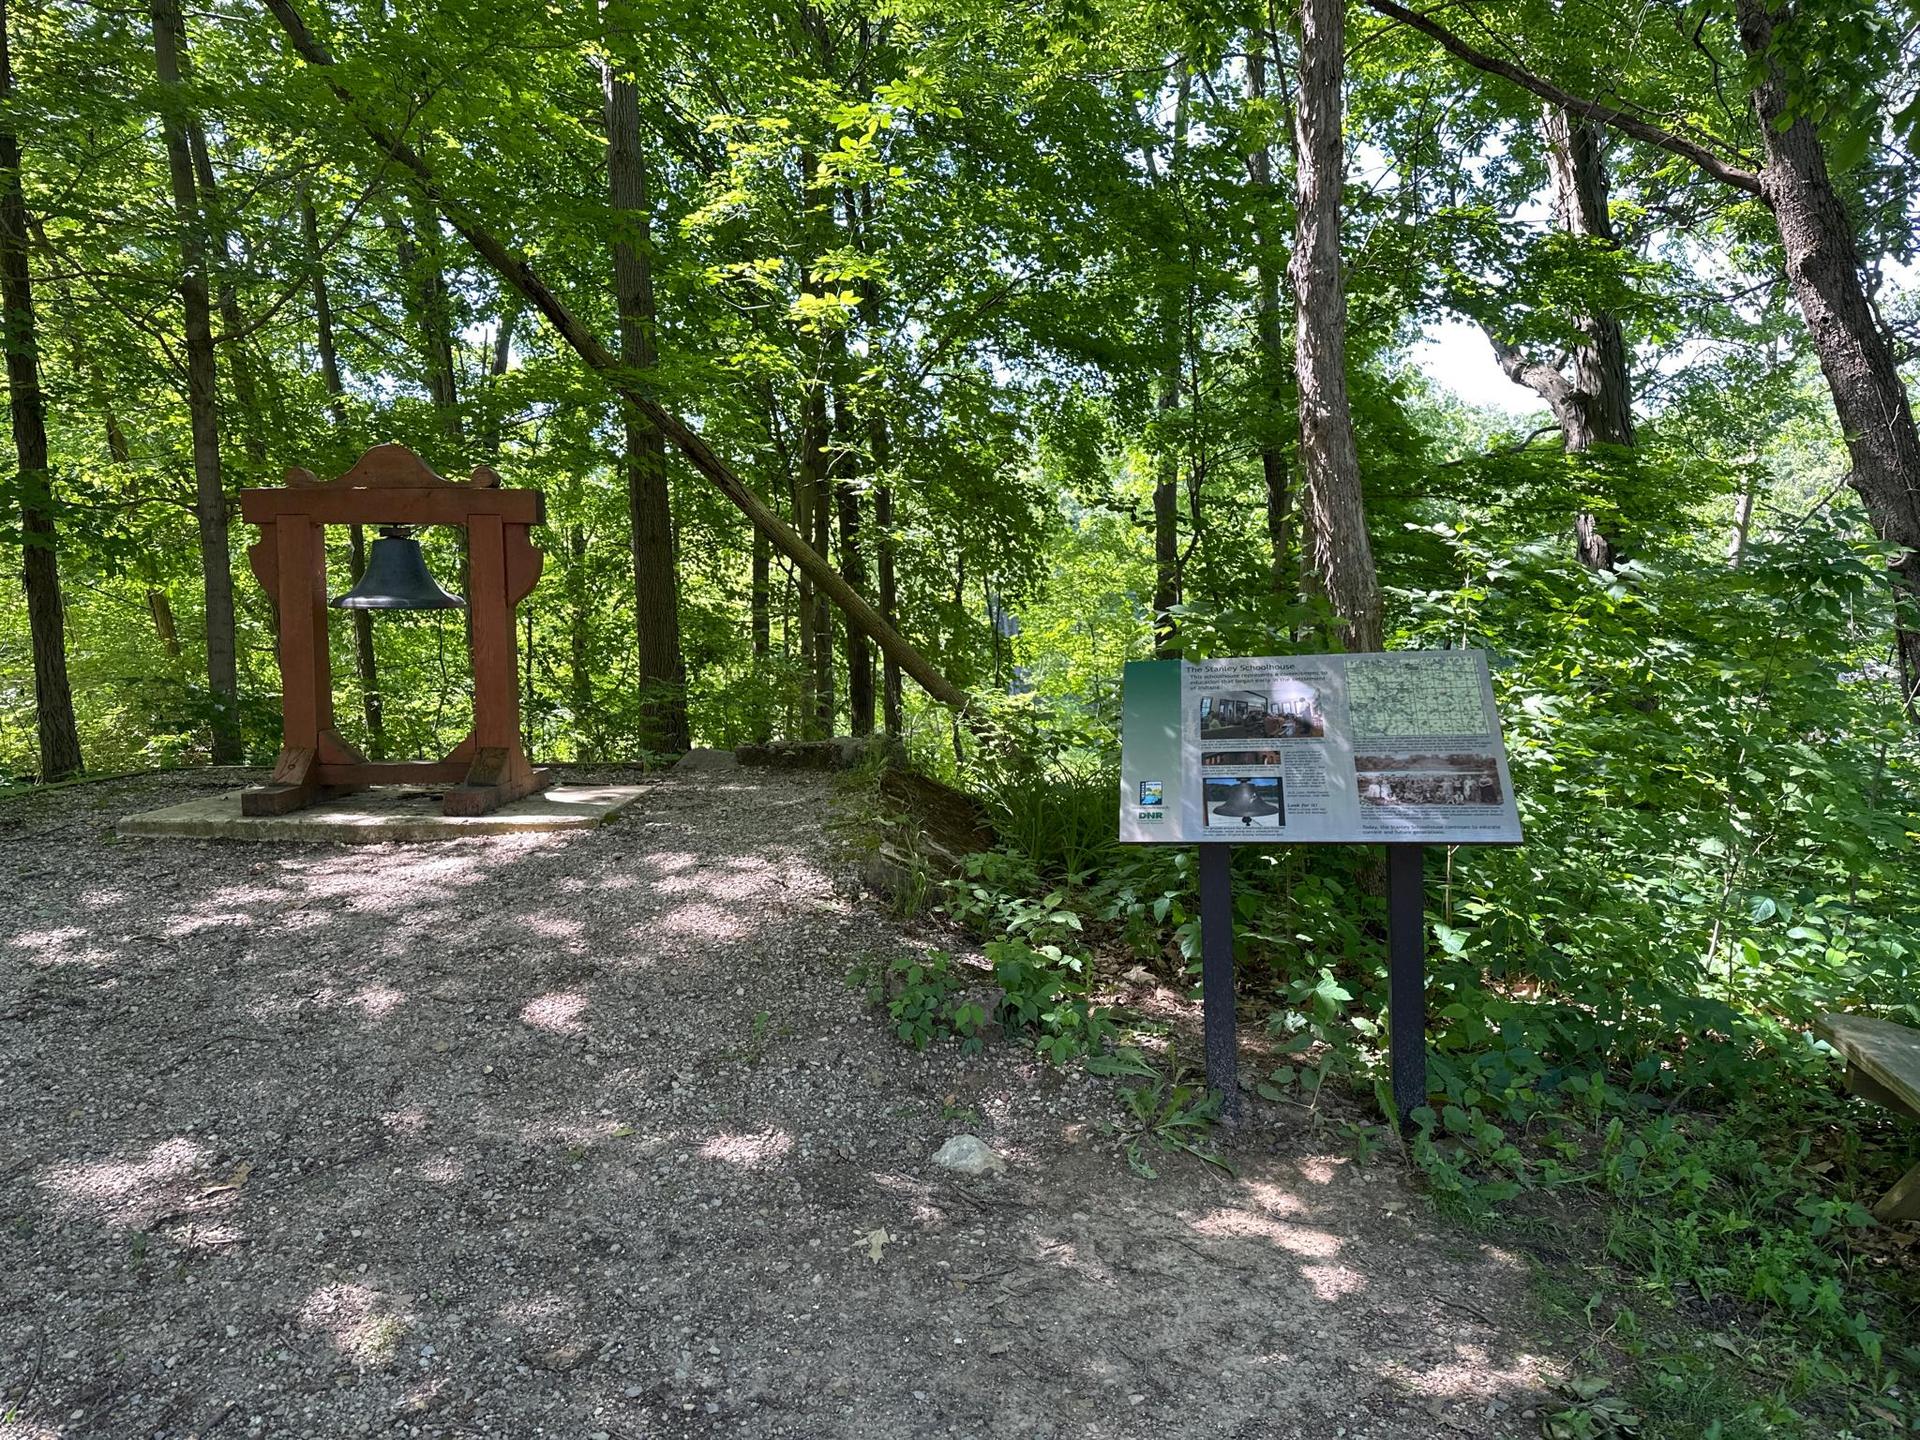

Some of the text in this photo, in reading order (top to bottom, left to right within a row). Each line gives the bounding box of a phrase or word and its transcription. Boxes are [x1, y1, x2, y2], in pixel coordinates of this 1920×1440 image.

[1204, 665, 1238, 674] Stanley
[1239, 664, 1296, 672] Schoolhouse
[1139, 811, 1163, 819] DNR
